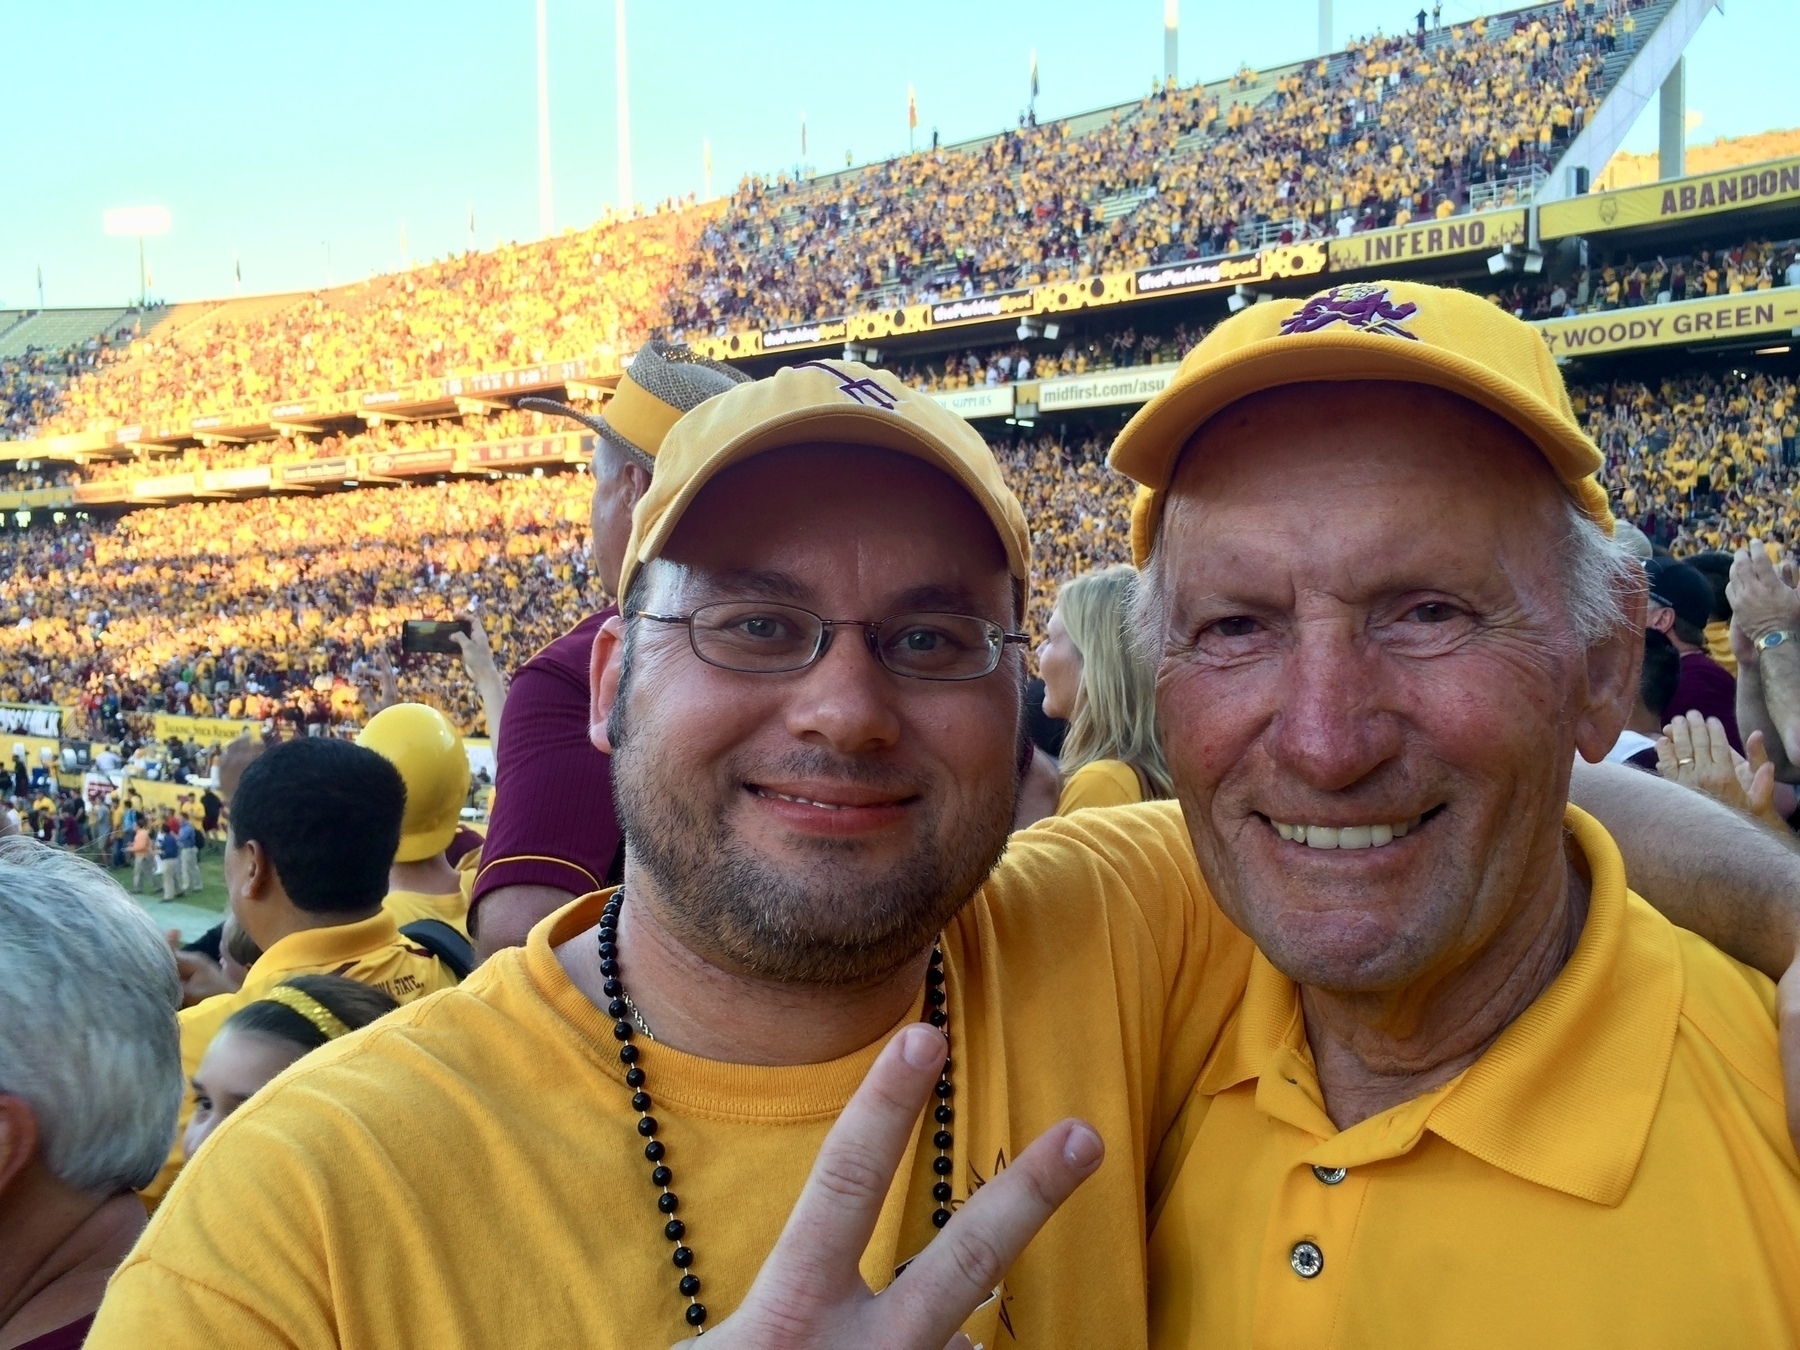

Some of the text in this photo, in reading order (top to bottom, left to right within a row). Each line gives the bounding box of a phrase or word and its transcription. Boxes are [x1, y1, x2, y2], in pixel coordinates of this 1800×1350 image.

[1661, 165, 1800, 215] ABANDON
[1365, 220, 1485, 262] INFERNO
[1563, 316, 1664, 349] WOODY
[1673, 303, 1775, 334] GREEN
[952, 395, 992, 409] SUPPLIES
[1043, 378, 1166, 404] midfirst.com/asu
